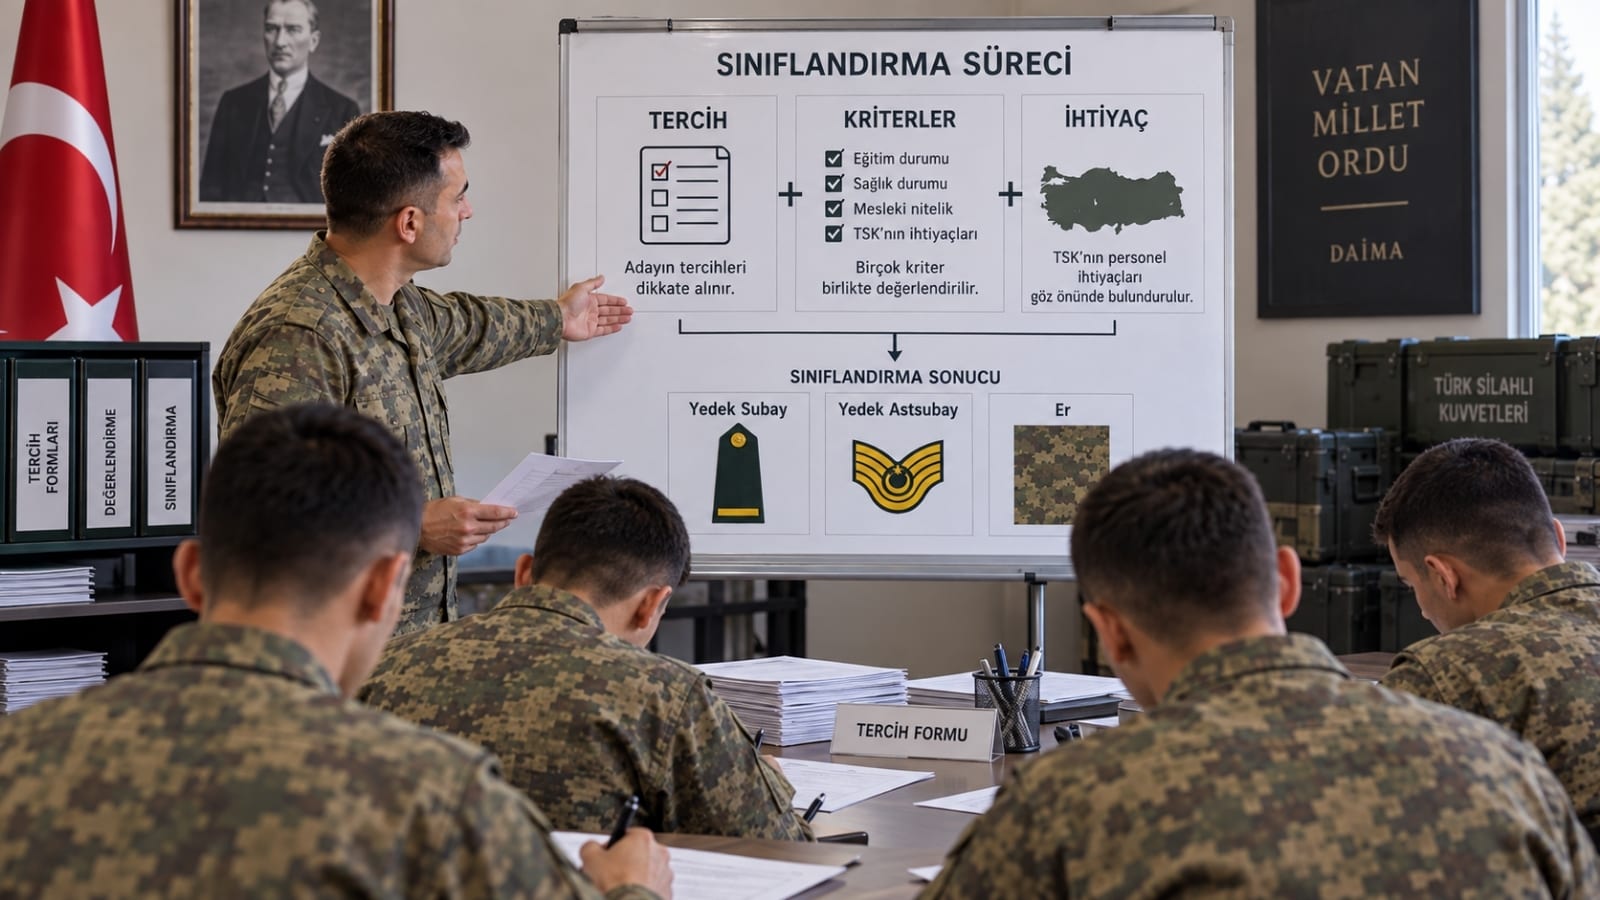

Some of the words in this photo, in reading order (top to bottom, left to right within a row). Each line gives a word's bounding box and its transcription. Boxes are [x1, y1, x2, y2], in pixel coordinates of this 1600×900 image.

[716, 51, 952, 77] SINIFLANDIRMA
[962, 44, 1071, 76] SÜRECİ
[1312, 58, 1420, 96] VATAN
[648, 105, 727, 130] TERCİH
[844, 105, 956, 129] KRİTERLER
[1065, 103, 1149, 133] İHTİYAÇ
[1313, 99, 1425, 137] MİLLET
[853, 151, 895, 169] Eğitim
[899, 151, 950, 165] durumu
[1318, 143, 1409, 178] ORDU
[853, 176, 893, 193] Sağlık
[897, 176, 948, 190] durumu
[853, 201, 907, 216] Mesleki
[911, 201, 953, 216] nitelik
[909, 226, 978, 244] ihtiyaçları
[1108, 250, 1167, 268] personel
[1330, 237, 1404, 263] DAİMA
[624, 259, 675, 278] Adayın
[679, 259, 746, 275] tercihleri
[856, 259, 901, 278] Birçok
[905, 259, 945, 274] kriter
[1078, 269, 1142, 287] ihtiyaçları
[636, 280, 690, 295] dikkate
[694, 280, 735, 295] alınır.
[822, 280, 872, 295] birlikte
[876, 280, 979, 298] değerlendirilir.
[1030, 289, 1053, 306] göz
[1056, 289, 1105, 303] önünde
[1108, 289, 1193, 303] bulundurulur.
[790, 369, 923, 385] SINIFLANDIRMA
[928, 369, 1001, 385] SONUCU
[1433, 372, 1473, 396] TÜRK
[1476, 372, 1534, 396] SİLAHLI
[688, 401, 736, 416] Yedek
[741, 401, 788, 420] Subay
[838, 401, 884, 417] Yedek
[888, 401, 959, 420] Astsubay
[1055, 402, 1072, 417] Er
[1439, 400, 1529, 423] KUVVETLERİ
[25, 433, 41, 484] TERCİH
[46, 421, 59, 494] FORMLARI
[102, 408, 117, 516] DEĞERLENDİRME
[856, 721, 909, 740] TERCİH
[913, 725, 968, 742] FORMU
